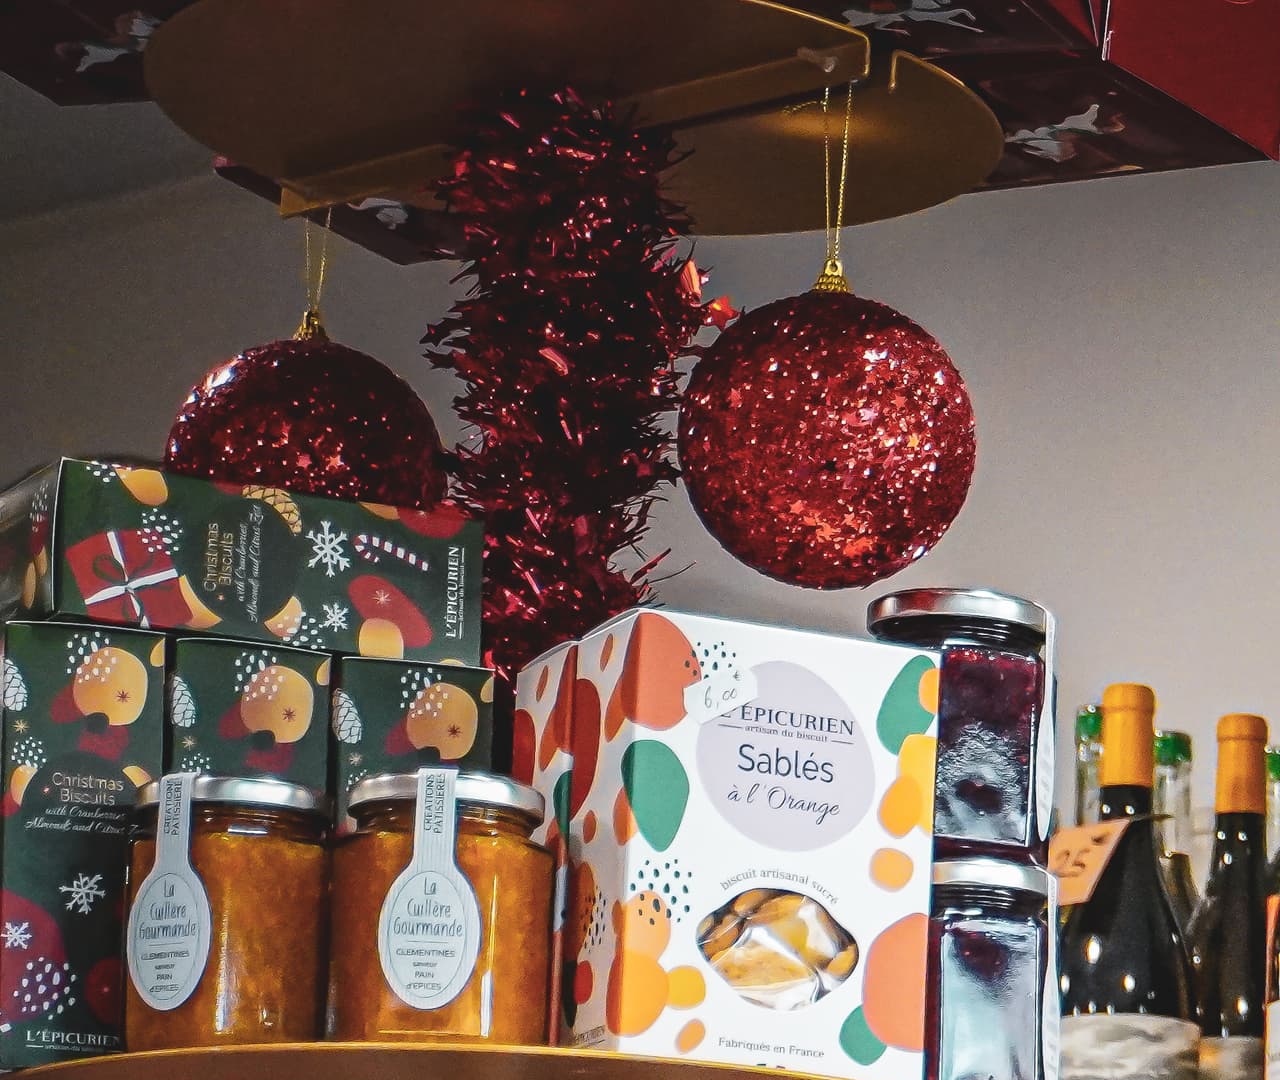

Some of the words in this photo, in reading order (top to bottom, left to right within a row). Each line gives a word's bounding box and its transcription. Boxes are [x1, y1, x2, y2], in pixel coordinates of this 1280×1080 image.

[204, 523, 219, 592] Christmas
[219, 532, 234, 586] Biscuits
[745, 725, 779, 736] artisan
[782, 729, 794, 738] du
[796, 731, 829, 743] biscuit
[737, 743, 834, 783] Sablés
[52, 772, 124, 791] Christmas
[60, 788, 116, 806] Biscuits
[727, 784, 741, 802] à
[163, 879, 175, 898] La
[423, 876, 437, 896] La
[720, 869, 757, 891] biscuit
[759, 869, 809, 886] artisanal
[150, 903, 187, 921] Cuillère
[407, 898, 452, 918] Cuillère
[138, 919, 197, 940] Gourmande
[392, 916, 464, 938] Gourmande
[156, 973, 173, 981] PAIN
[414, 971, 435, 979] PAIN
[773, 1045, 787, 1054] en
[788, 1045, 825, 1059] France
